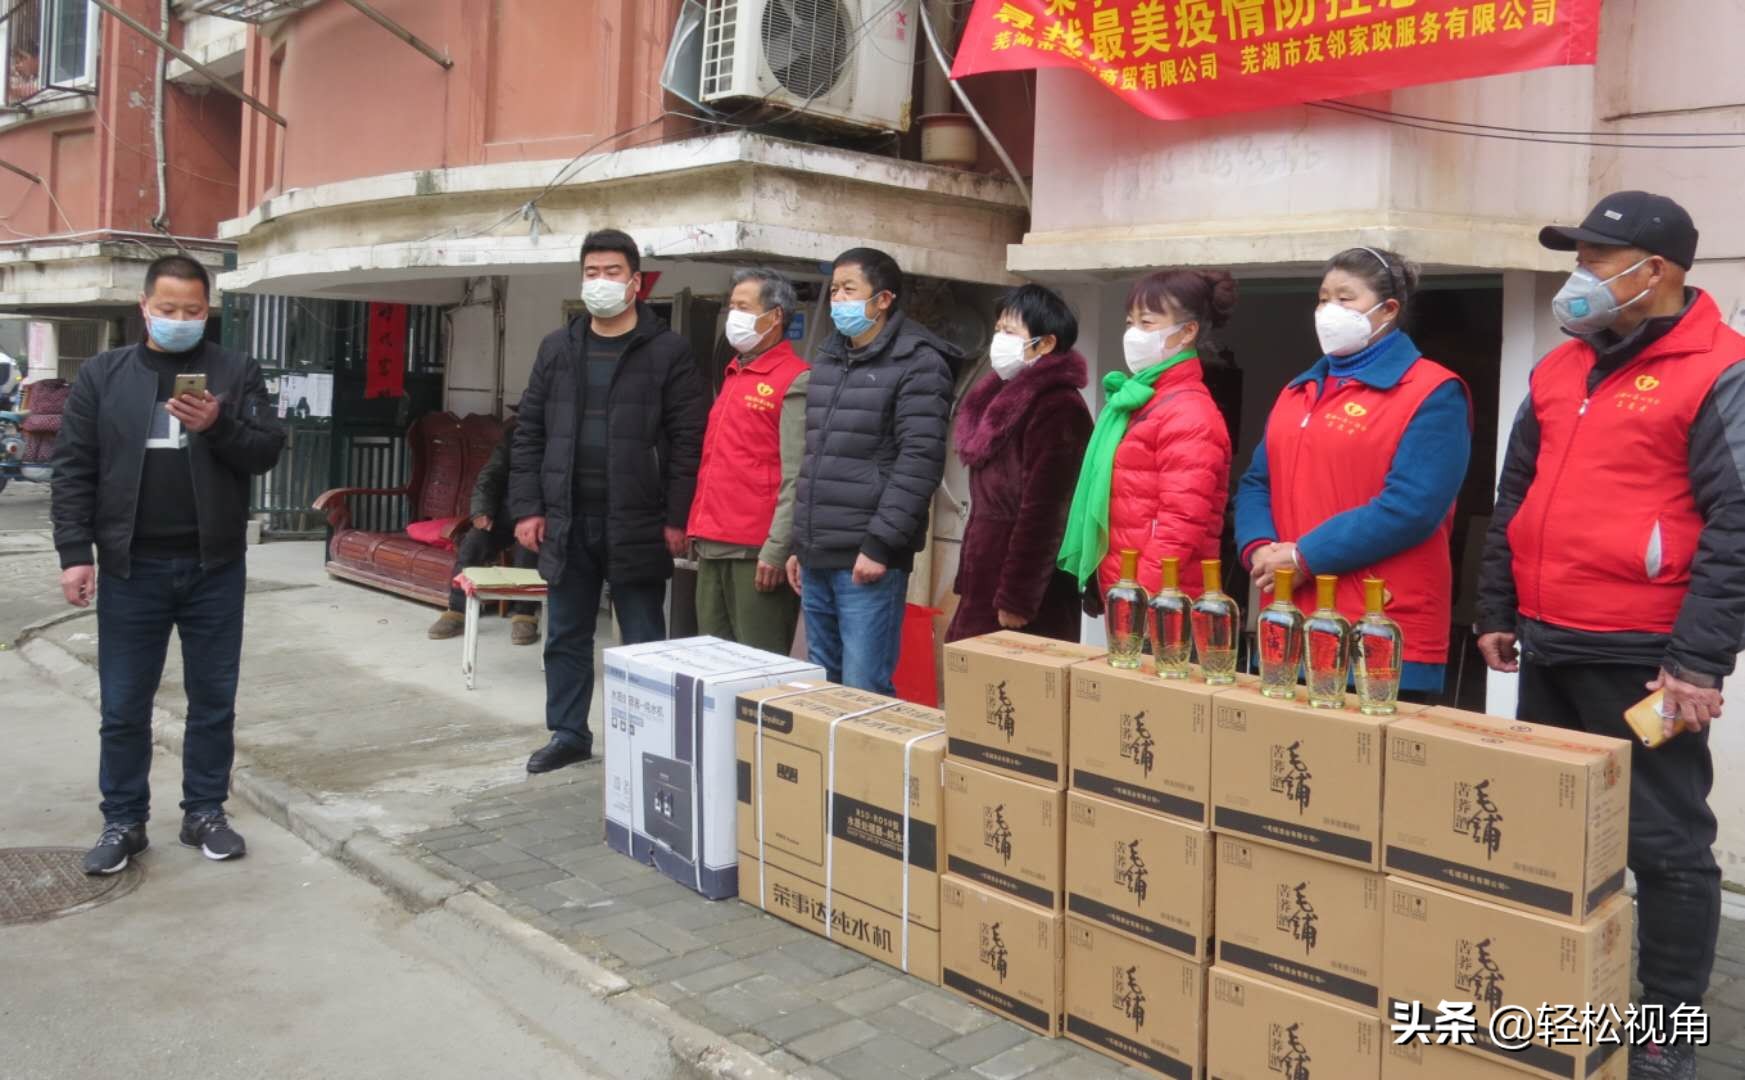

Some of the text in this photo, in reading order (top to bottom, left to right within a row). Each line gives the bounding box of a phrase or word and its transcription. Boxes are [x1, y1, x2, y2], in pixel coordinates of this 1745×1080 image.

[1241, 0, 1556, 75] 芜湖市友邻家政服务有限公司
[773, 882, 893, 953] 荣事达纯水机
